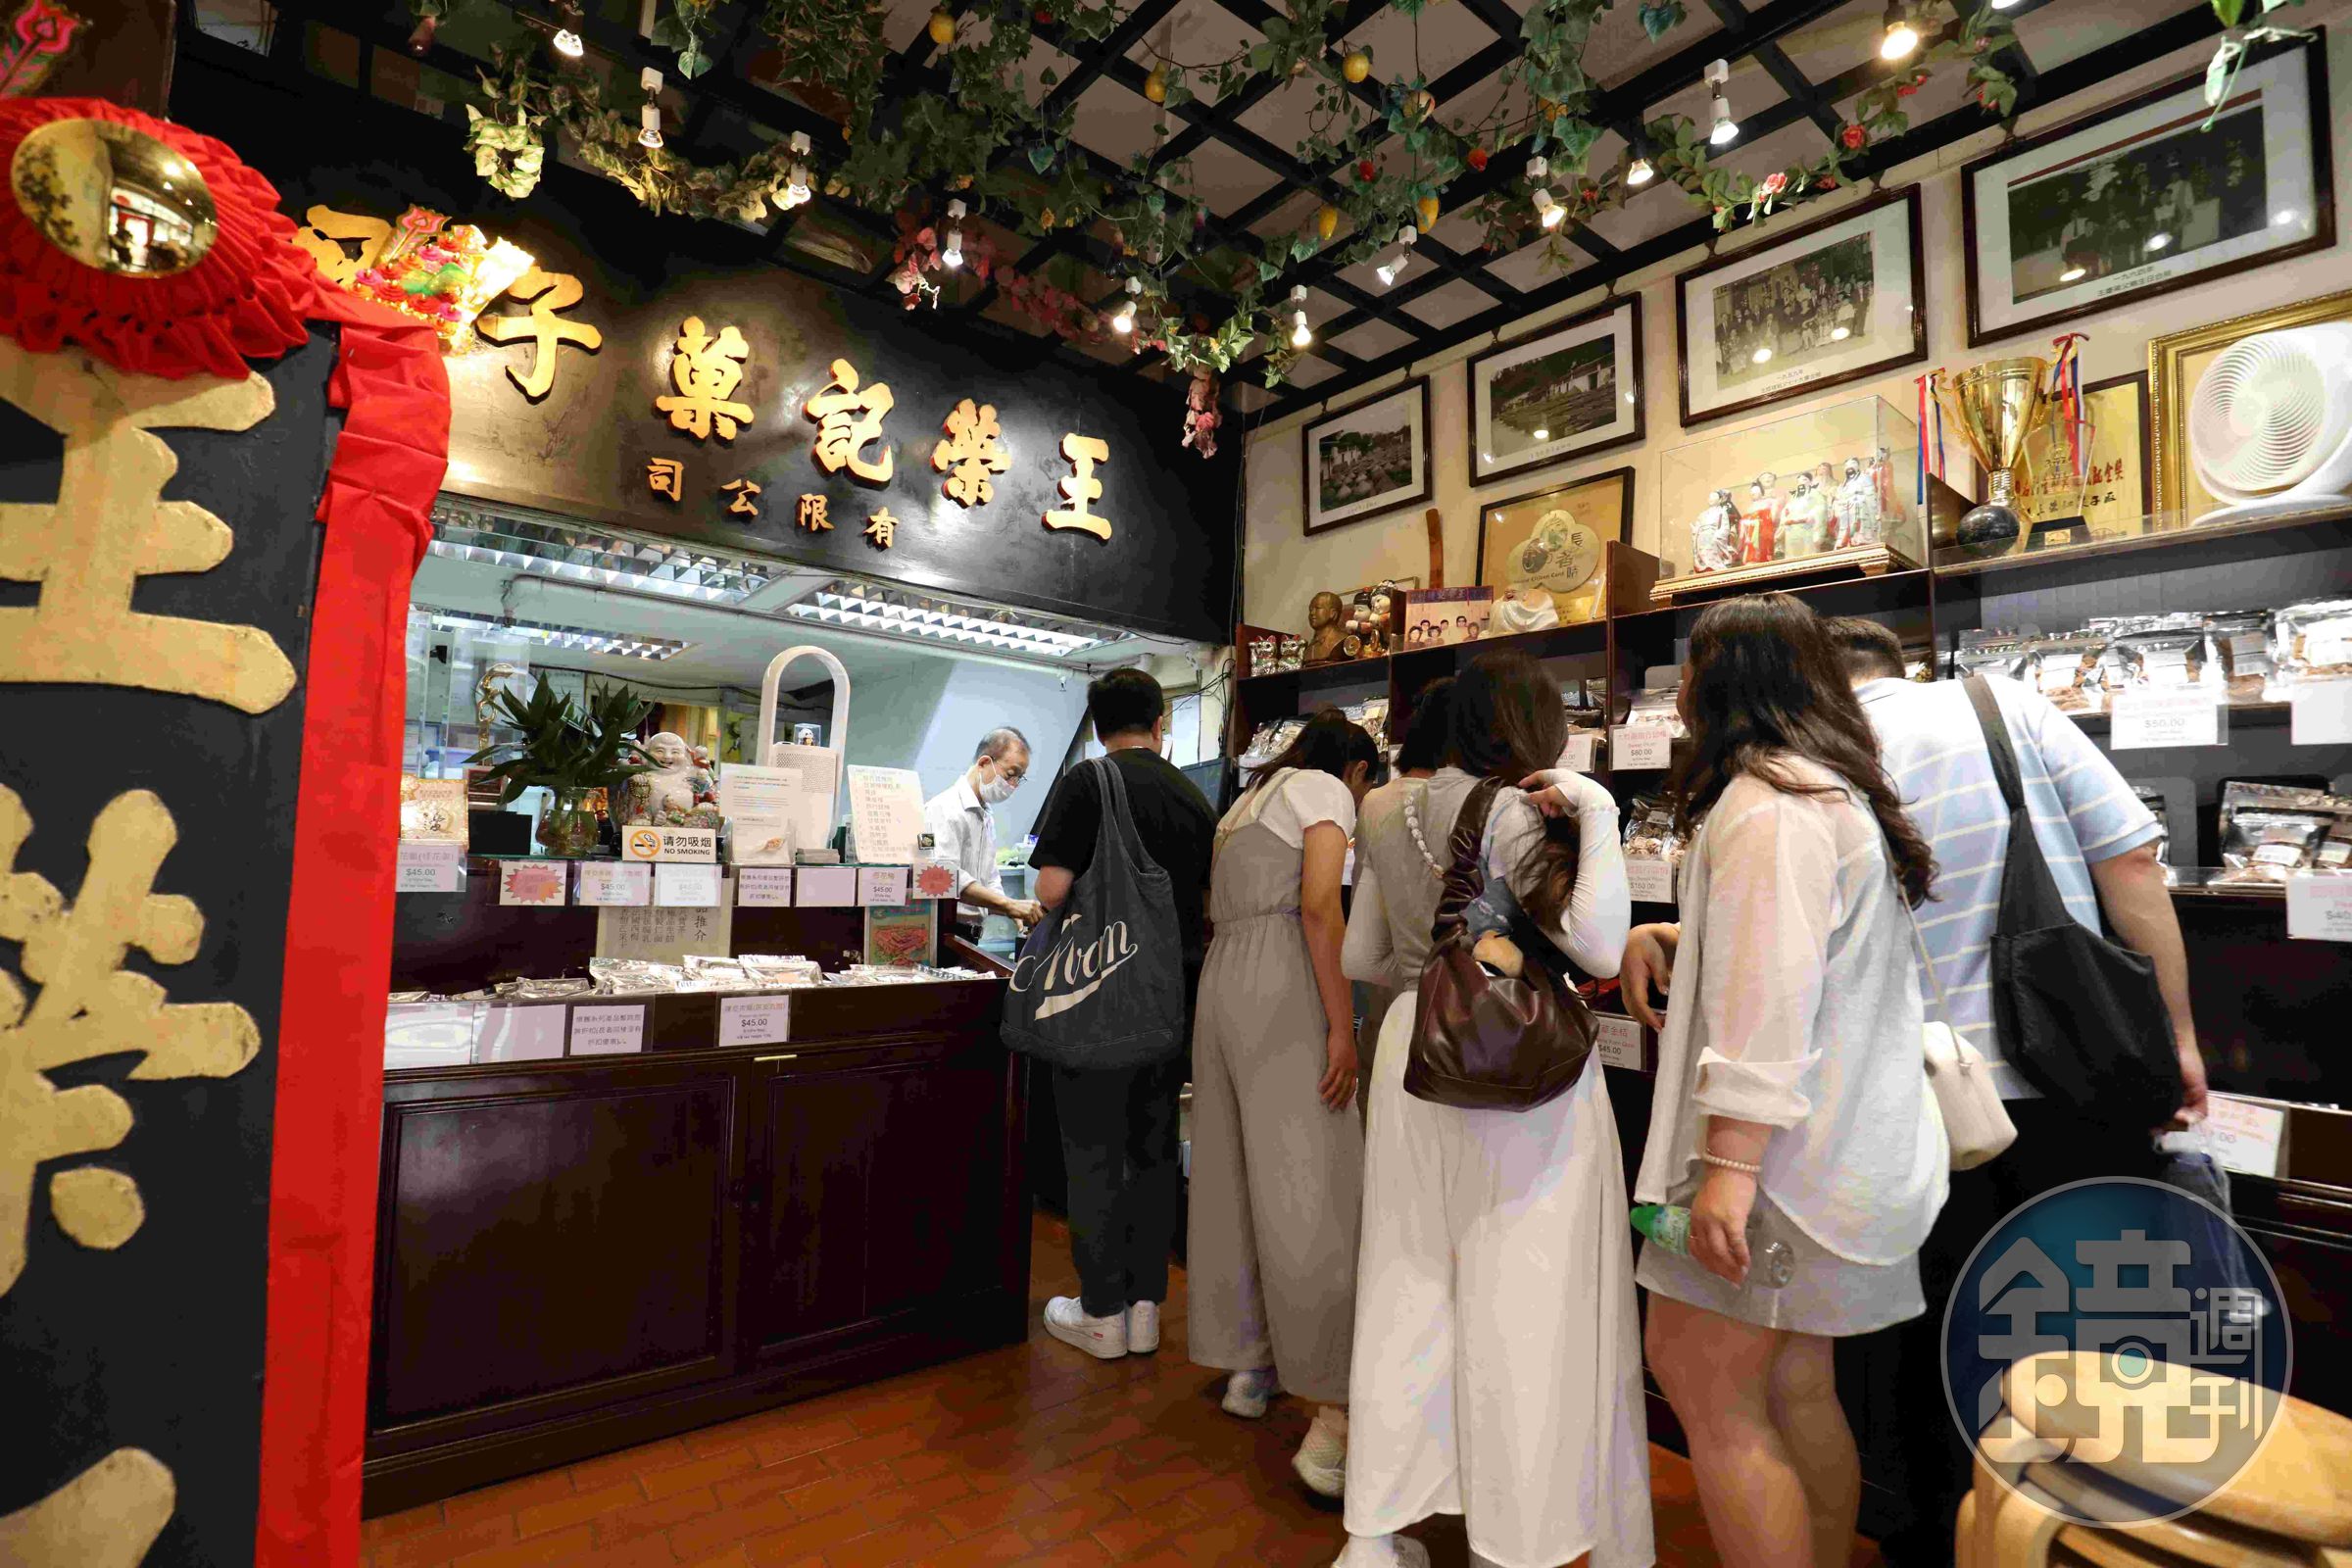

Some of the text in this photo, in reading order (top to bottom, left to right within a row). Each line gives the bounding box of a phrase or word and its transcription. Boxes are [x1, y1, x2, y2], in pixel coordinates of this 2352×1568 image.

[647, 458, 899, 548] 有限公司
[663, 835, 711, 849] 请勿吸烟
[406, 868, 436, 877] $45.00
[741, 1018, 767, 1027] $45.00
